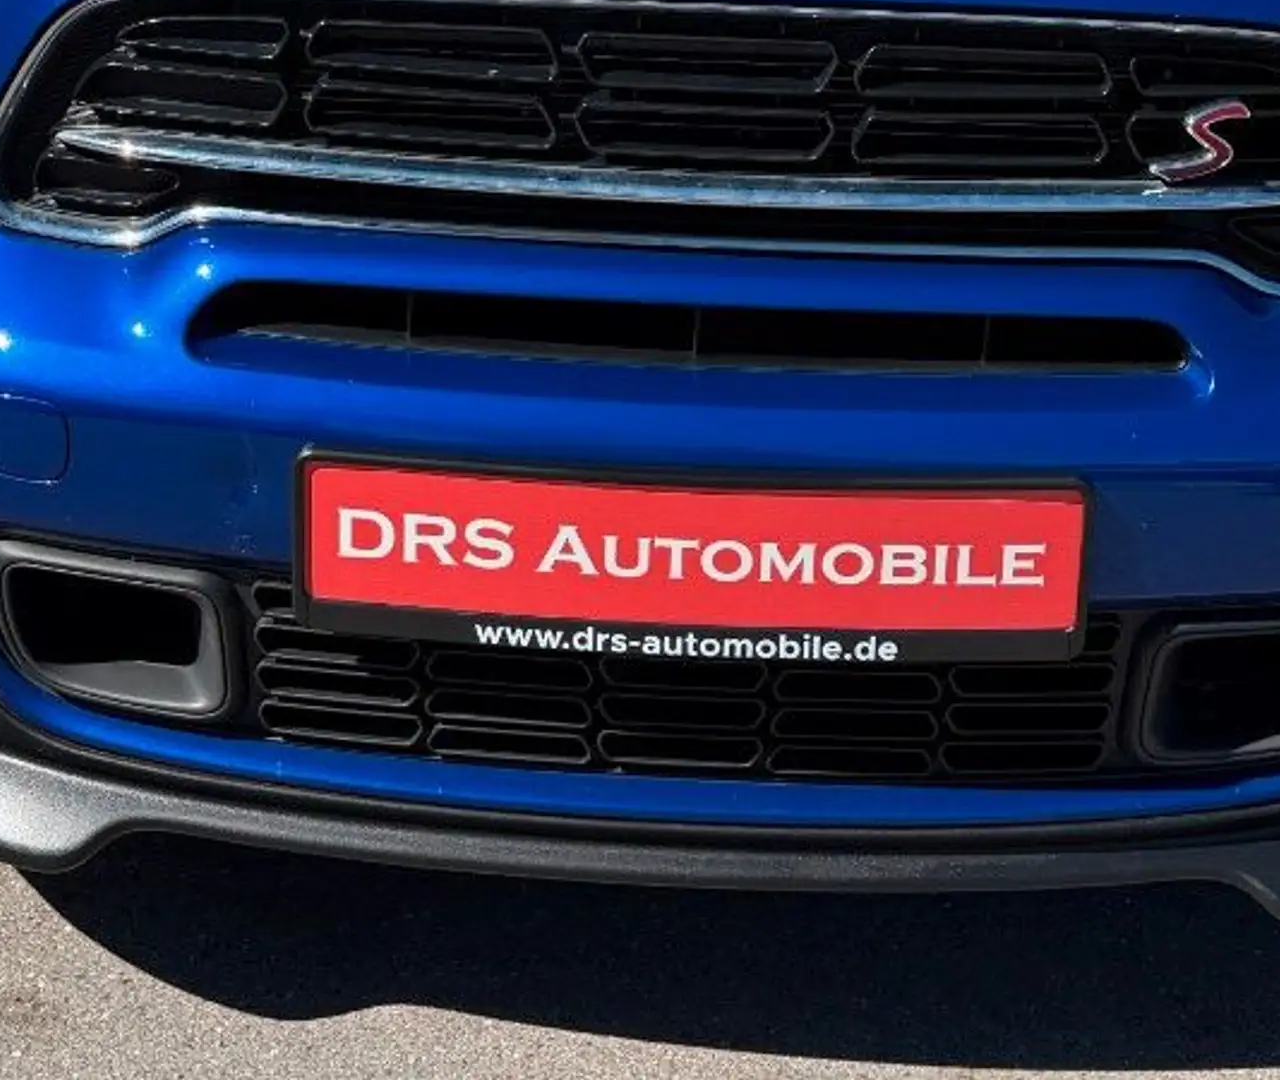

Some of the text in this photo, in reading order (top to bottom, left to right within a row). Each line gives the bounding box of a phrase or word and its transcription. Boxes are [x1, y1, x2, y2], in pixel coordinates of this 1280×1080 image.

[1148, 100, 1252, 183] S
[336, 507, 516, 571] DRS
[474, 623, 900, 663] www.drs-automobile.de
